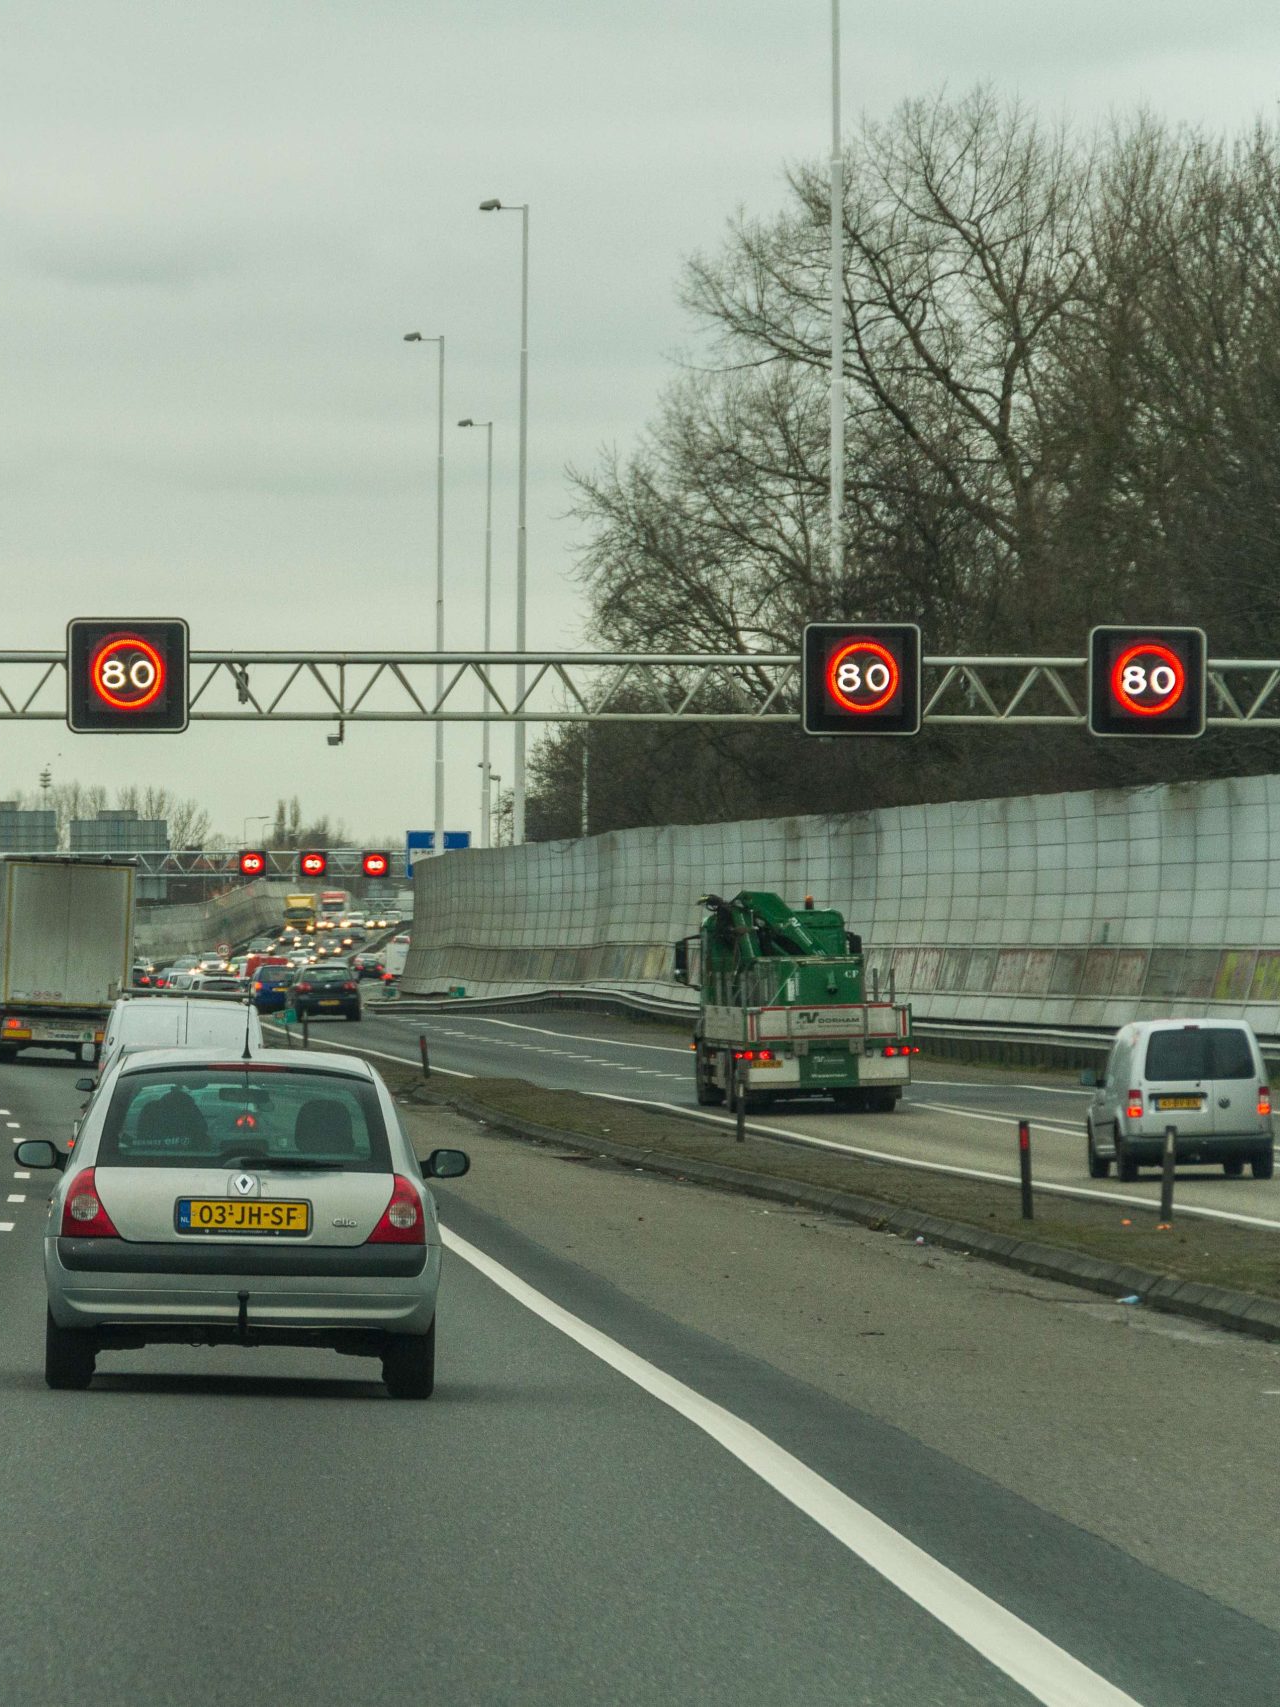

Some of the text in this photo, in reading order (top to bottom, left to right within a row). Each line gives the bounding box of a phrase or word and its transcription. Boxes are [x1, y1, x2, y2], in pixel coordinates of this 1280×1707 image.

[102, 659, 156, 689] 80
[837, 663, 891, 693] 80
[1122, 666, 1176, 696] 80
[244, 859, 260, 869] 80
[305, 859, 322, 869] 80
[332, 1217, 358, 1228] Clio
